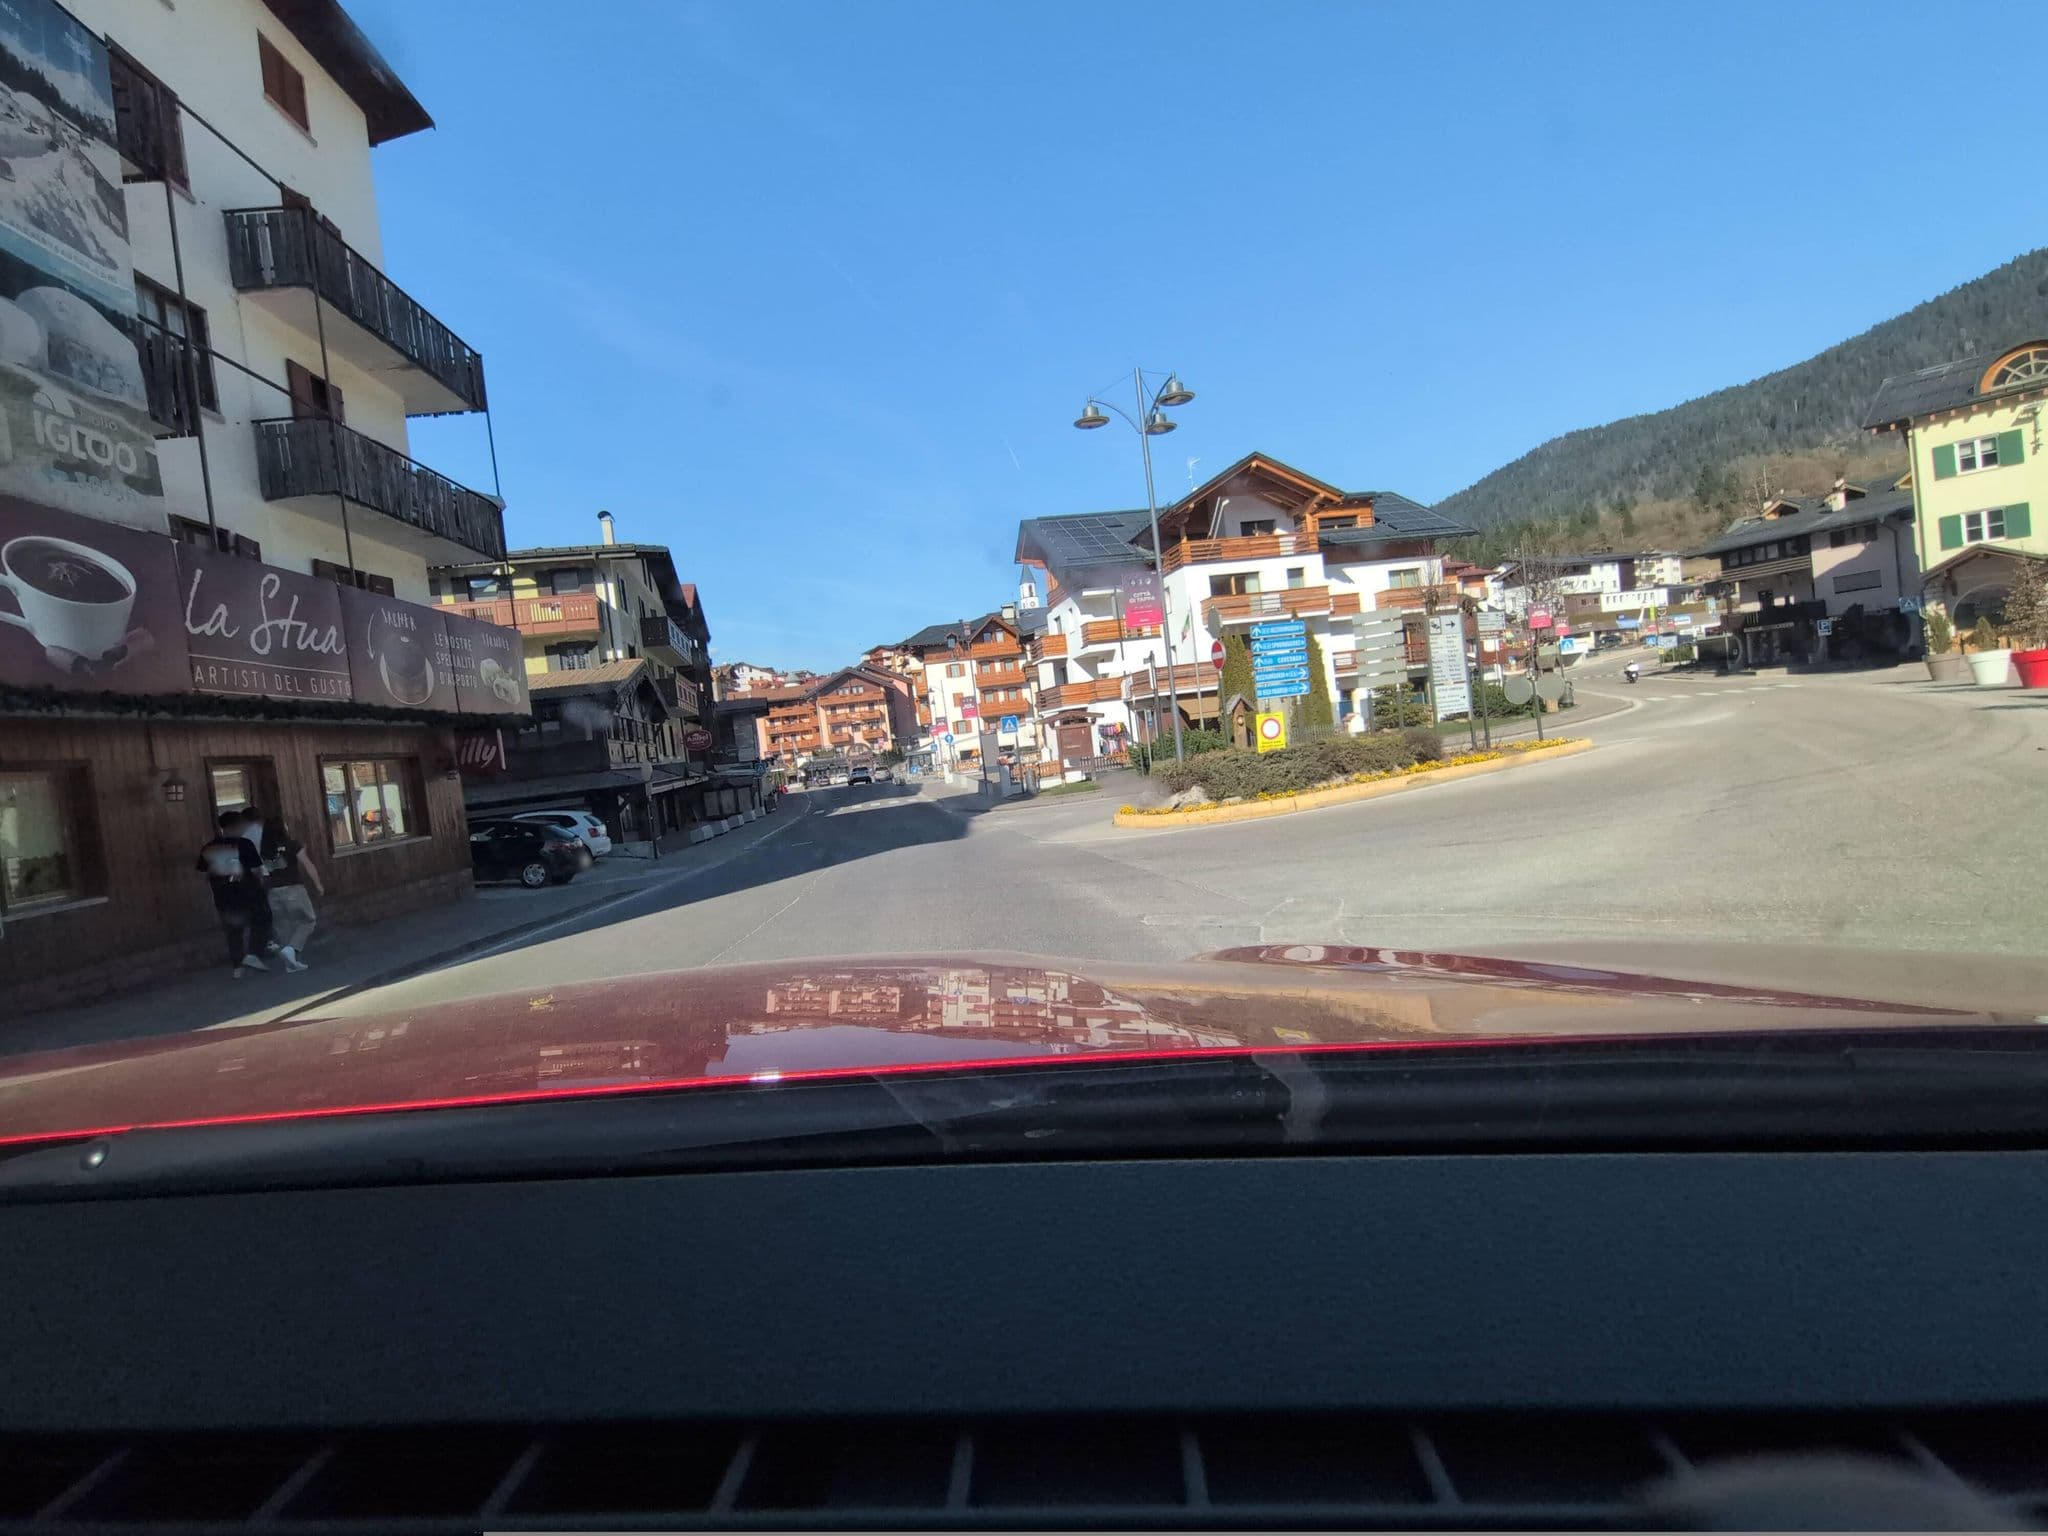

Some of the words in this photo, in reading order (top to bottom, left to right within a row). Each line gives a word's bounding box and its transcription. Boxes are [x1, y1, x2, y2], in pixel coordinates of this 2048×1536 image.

[33, 410, 137, 474] IGLOO
[185, 569, 240, 637] La
[250, 573, 346, 655] Stua
[433, 633, 443, 648] LE
[444, 634, 473, 652] NOSTRE
[194, 665, 267, 689] ARTISTI
[274, 673, 303, 693] DEL
[310, 677, 352, 697] GUSTO
[460, 737, 497, 768] illy
